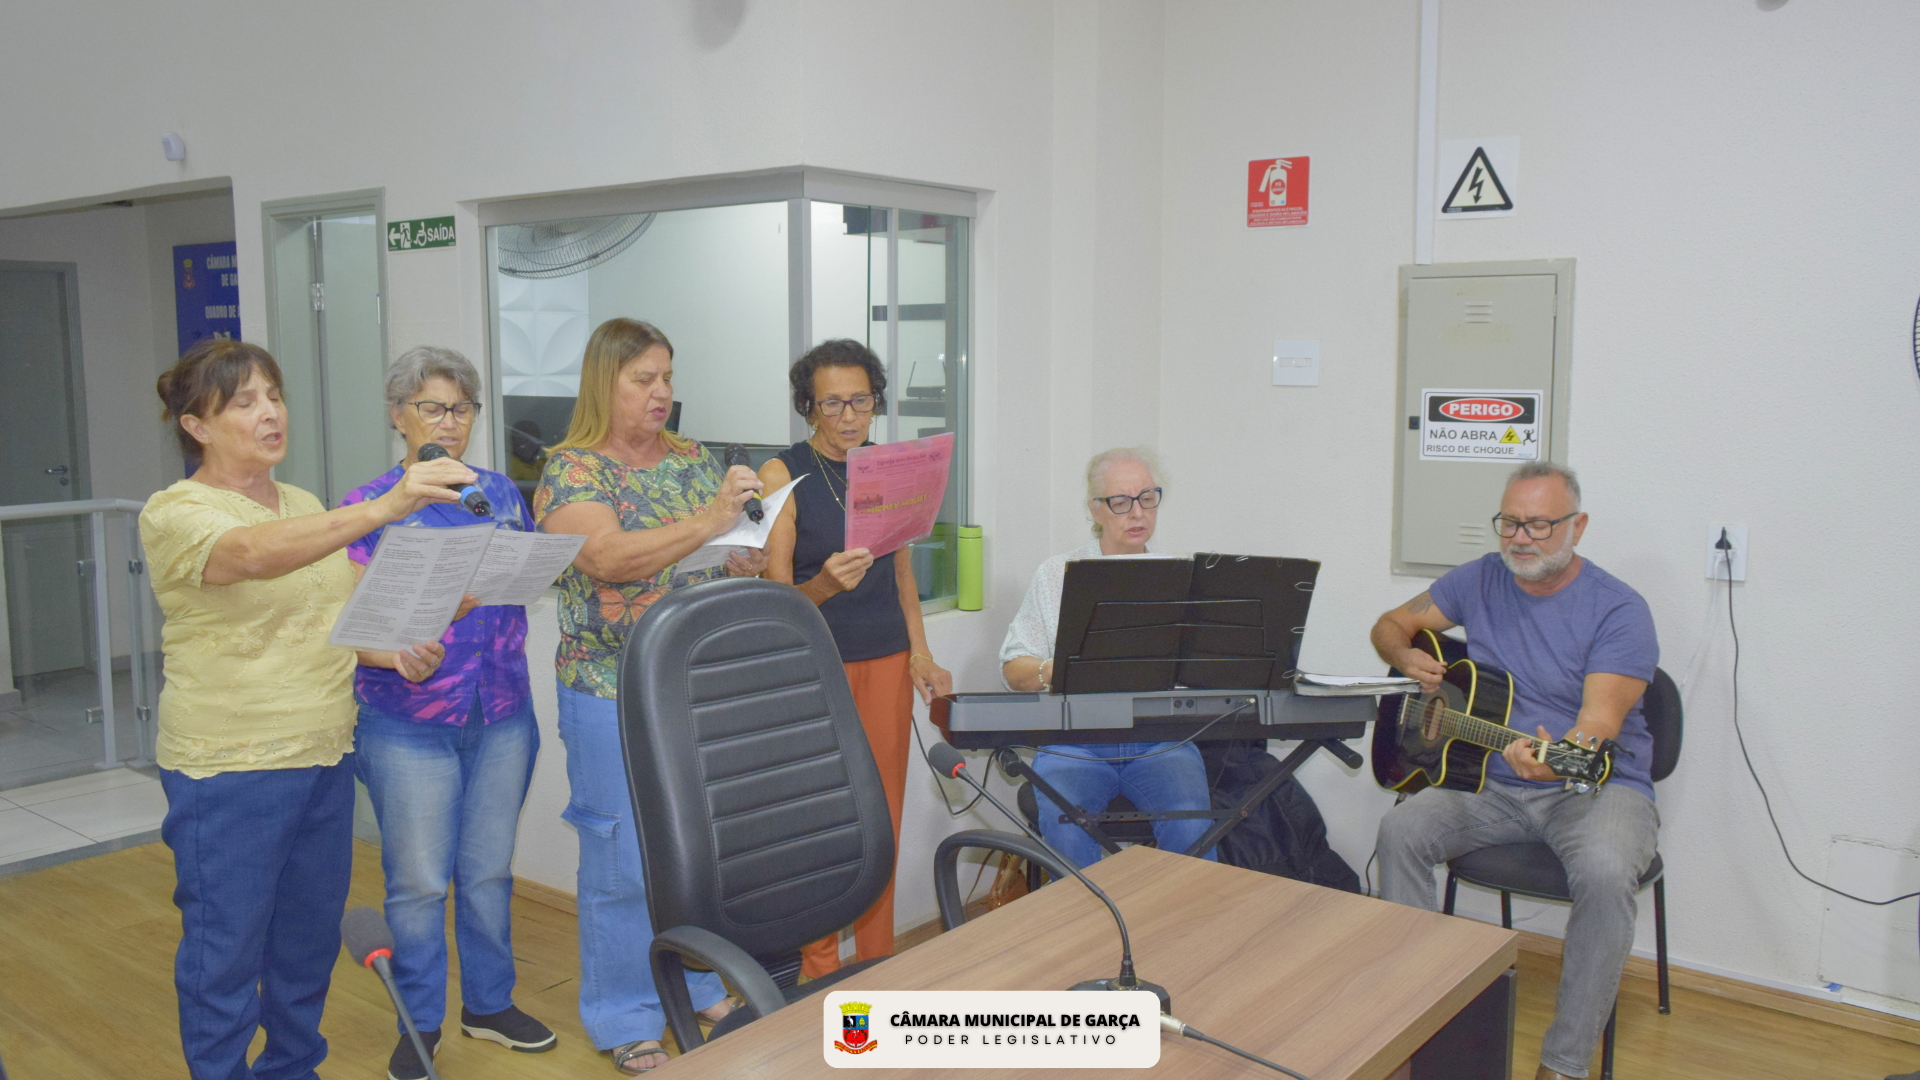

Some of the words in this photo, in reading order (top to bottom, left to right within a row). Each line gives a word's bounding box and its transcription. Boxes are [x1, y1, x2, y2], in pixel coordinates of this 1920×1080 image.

[427, 223, 455, 242] SAÍDA
[206, 254, 231, 270] CÂMARA
[221, 273, 229, 287] DE
[205, 305, 228, 319] QUADRO
[228, 304, 236, 318] DE
[1449, 403, 1514, 416] PERIGO
[1430, 427, 1457, 440] NÃO
[1460, 430, 1498, 441] ABRA
[1426, 445, 1455, 453] RISCO
[1458, 445, 1470, 453] DE
[1473, 446, 1514, 455] CHOQUE
[877, 458, 896, 467] Igreja
